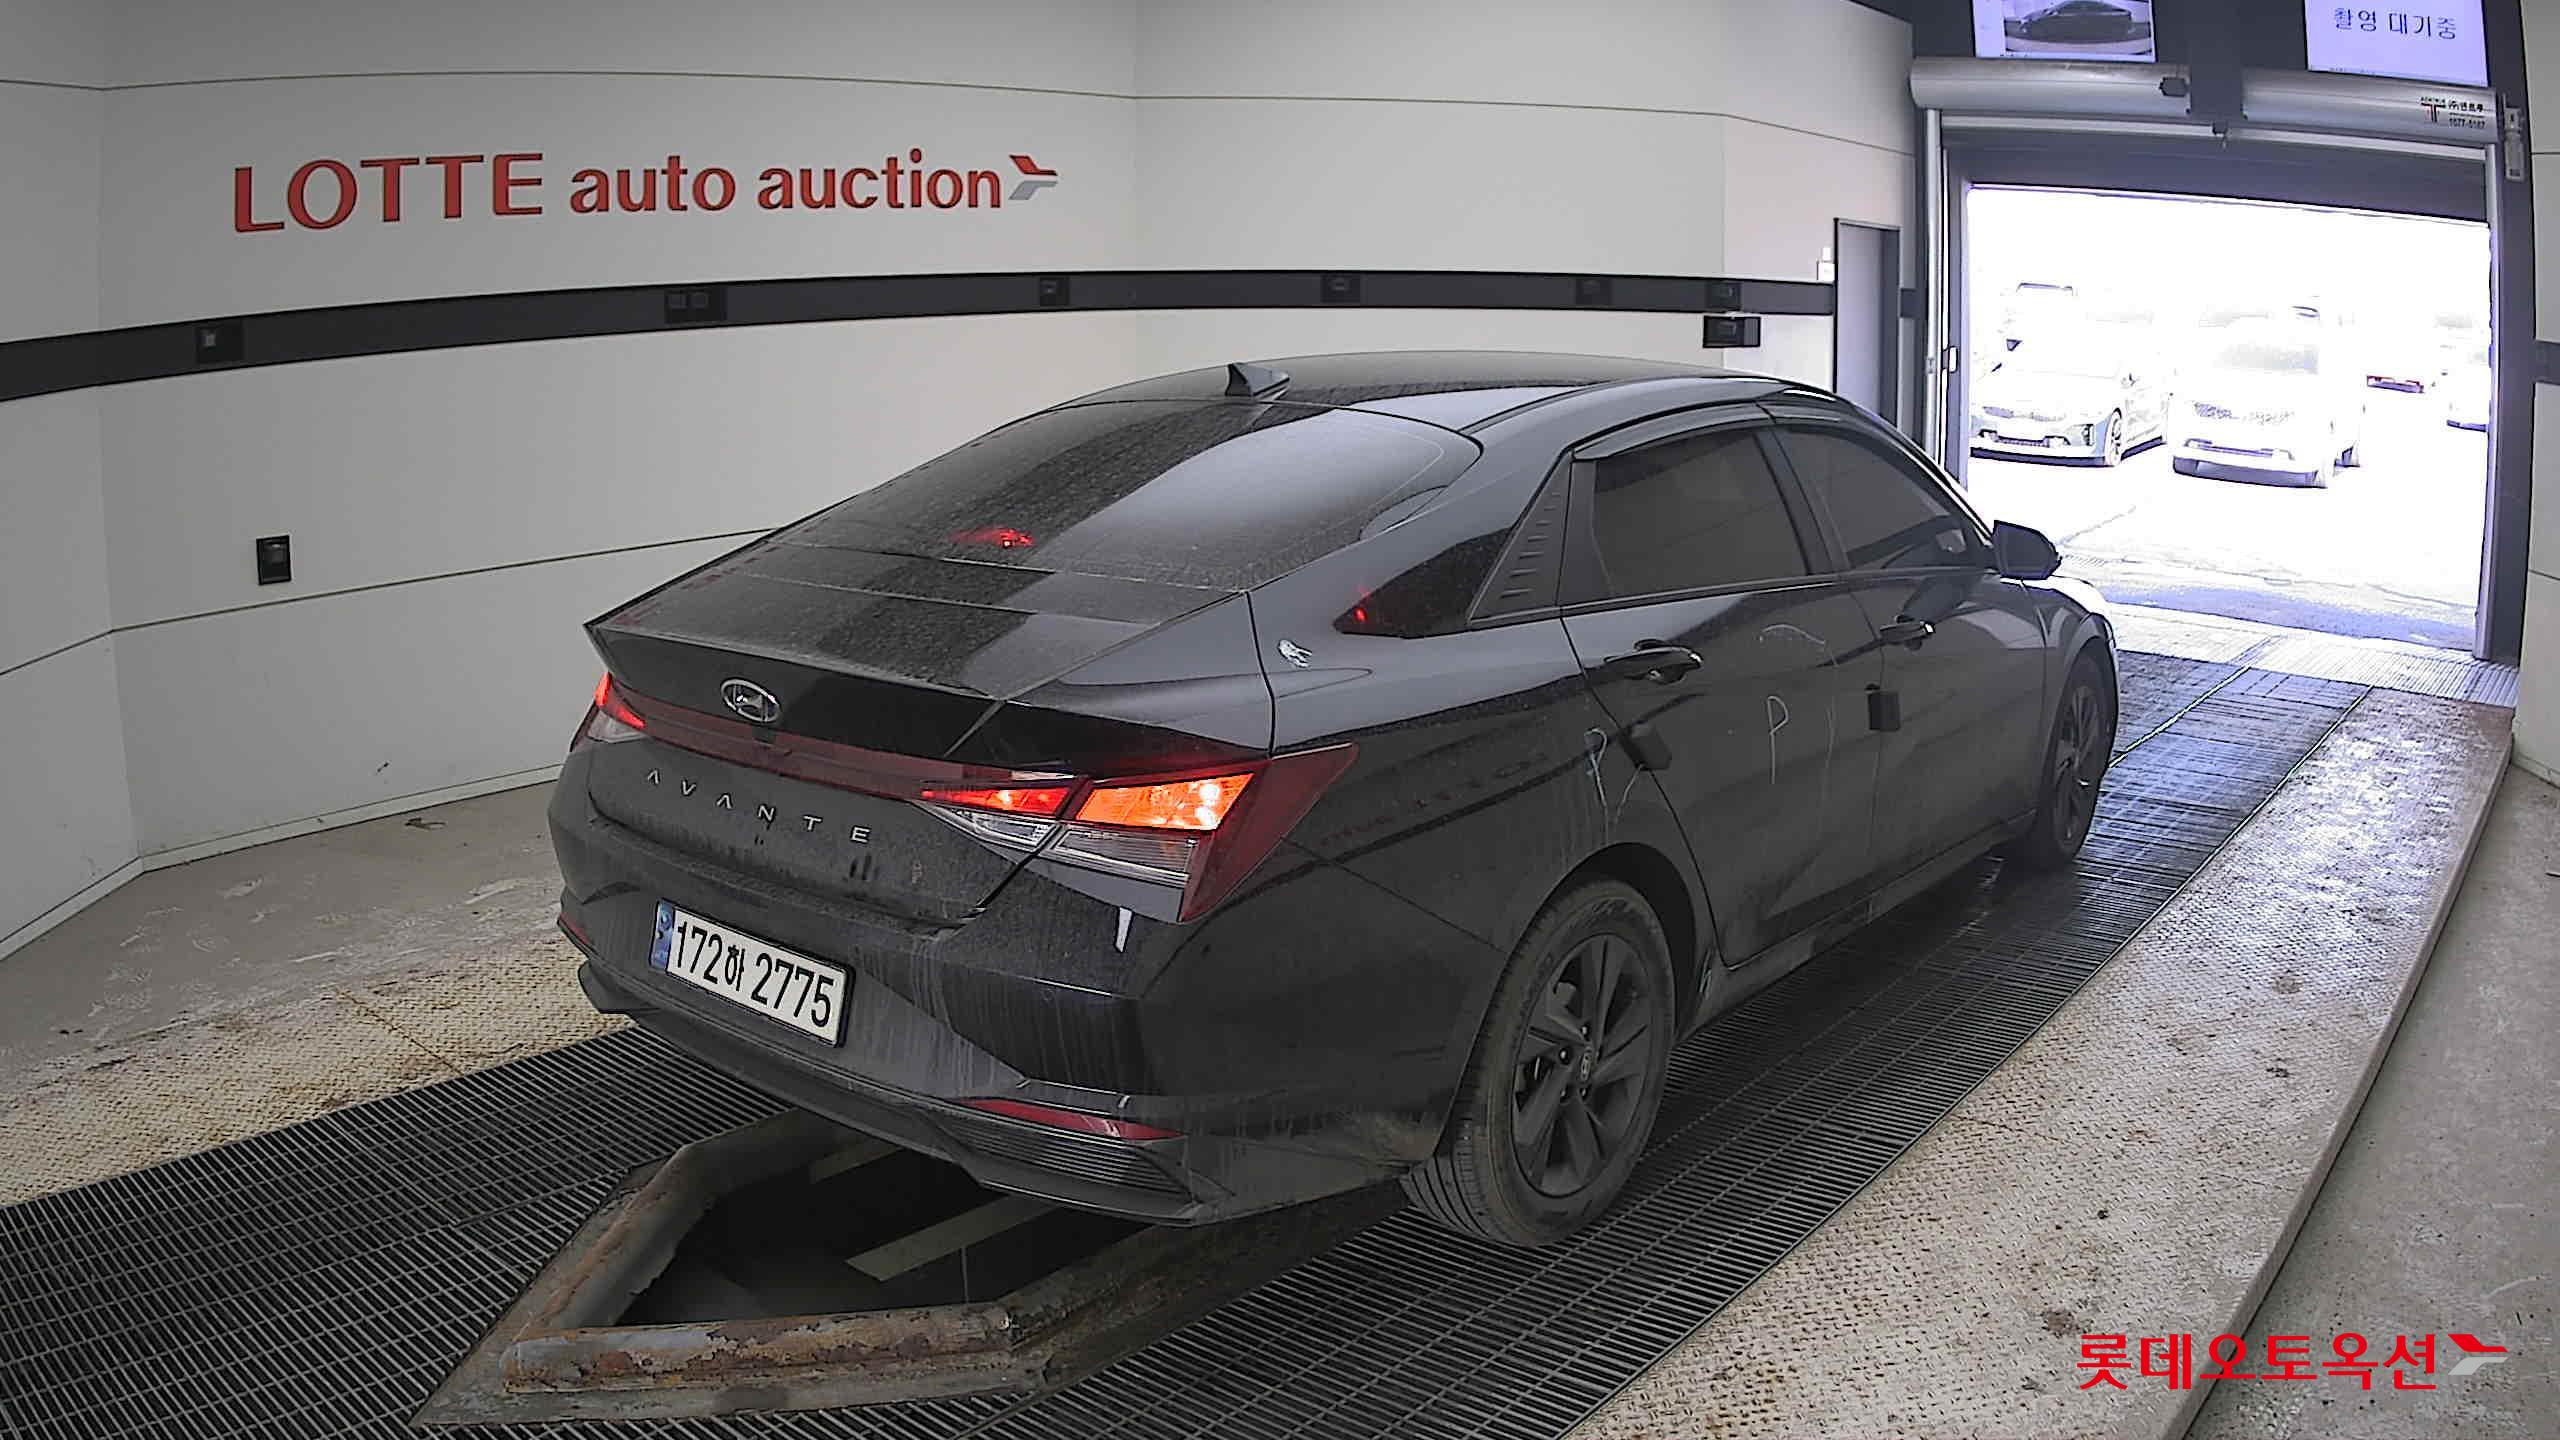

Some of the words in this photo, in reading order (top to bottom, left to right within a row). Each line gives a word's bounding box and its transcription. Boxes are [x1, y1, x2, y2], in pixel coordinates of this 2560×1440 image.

[2334, 7, 2377, 32] 촬영
[2388, 12, 2457, 40] 대기중
[235, 152, 544, 233] LOTTE
[569, 154, 737, 213] auto
[758, 147, 1003, 210] auction
[647, 769, 872, 843] AVANTE
[676, 921, 746, 992] 172하
[751, 952, 835, 1028] 2775
